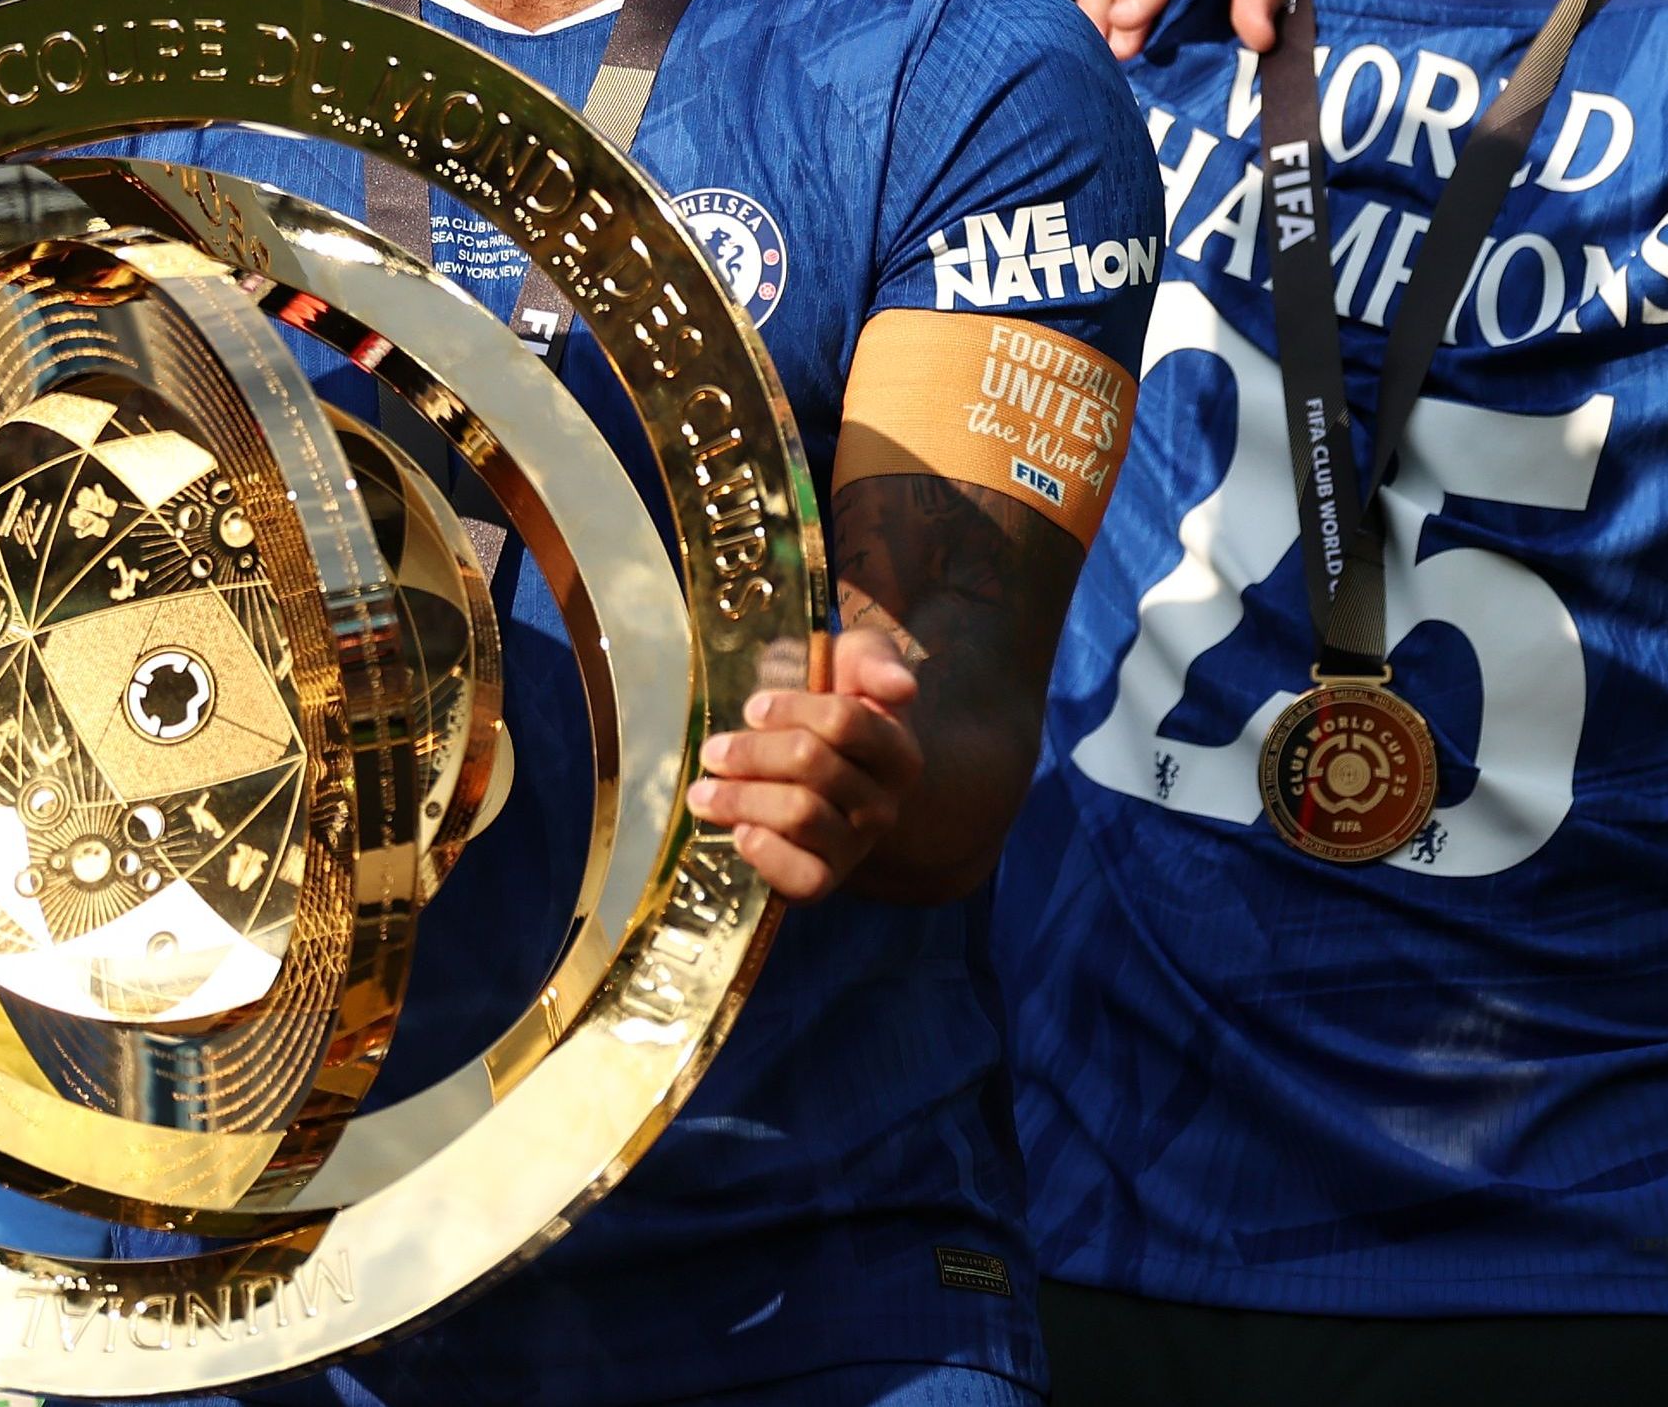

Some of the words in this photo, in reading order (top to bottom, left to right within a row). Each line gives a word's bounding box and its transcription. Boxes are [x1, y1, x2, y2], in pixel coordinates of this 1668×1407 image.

[451, 217, 486, 233] CLUB
[927, 201, 1072, 266] LIVE
[1269, 140, 1316, 253] FIFA
[435, 262, 464, 275] NEW
[456, 233, 475, 248] FC
[458, 248, 501, 264] SUNDAY
[934, 236, 1157, 310] NATION
[249, 21, 358, 98] DU
[368, 56, 614, 254] MONDE
[596, 234, 704, 379] DES
[681, 384, 774, 620] CLUBS
[981, 355, 1120, 452] UNITES
[989, 323, 1122, 413] FOOTBALL
[962, 400, 1022, 444] the
[1028, 421, 1110, 497] World
[1306, 396, 1327, 444] FIFA
[1015, 463, 1061, 502] FIFA
[1313, 444, 1334, 499] CLUB
[1318, 499, 1344, 577] WORLD
[1071, 280, 1616, 878] 25
[1289, 745, 1309, 797] CLUB
[1306, 715, 1375, 743] WORLD
[1379, 729, 1407, 767] CUP
[1393, 775, 1408, 798] 25
[1333, 820, 1362, 834] FIFA
[20, 1248, 357, 1355] MUNDIAL
